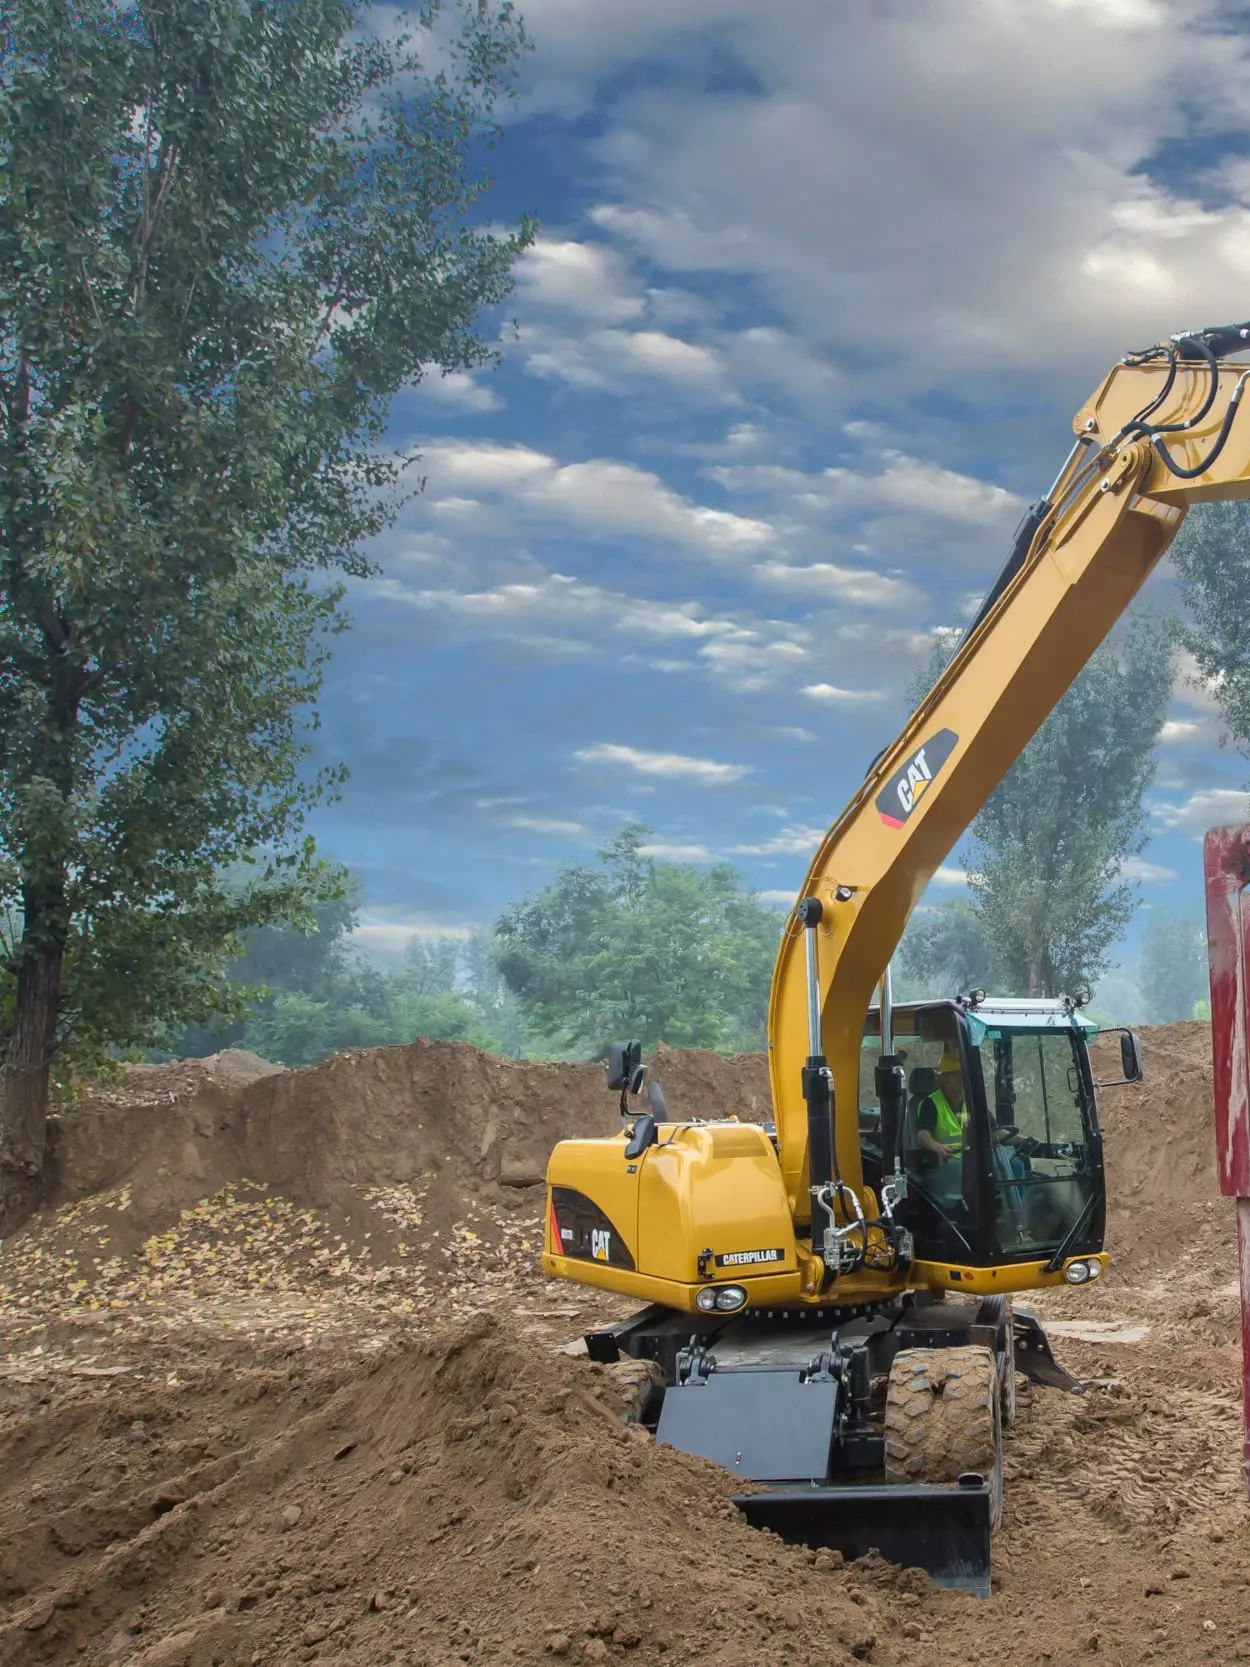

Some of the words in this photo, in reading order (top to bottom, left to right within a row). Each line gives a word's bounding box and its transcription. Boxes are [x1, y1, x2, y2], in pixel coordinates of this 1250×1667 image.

[896, 748, 933, 813] CAT
[592, 1228, 611, 1261] CAT
[722, 1249, 778, 1266] CATERPILLAR
